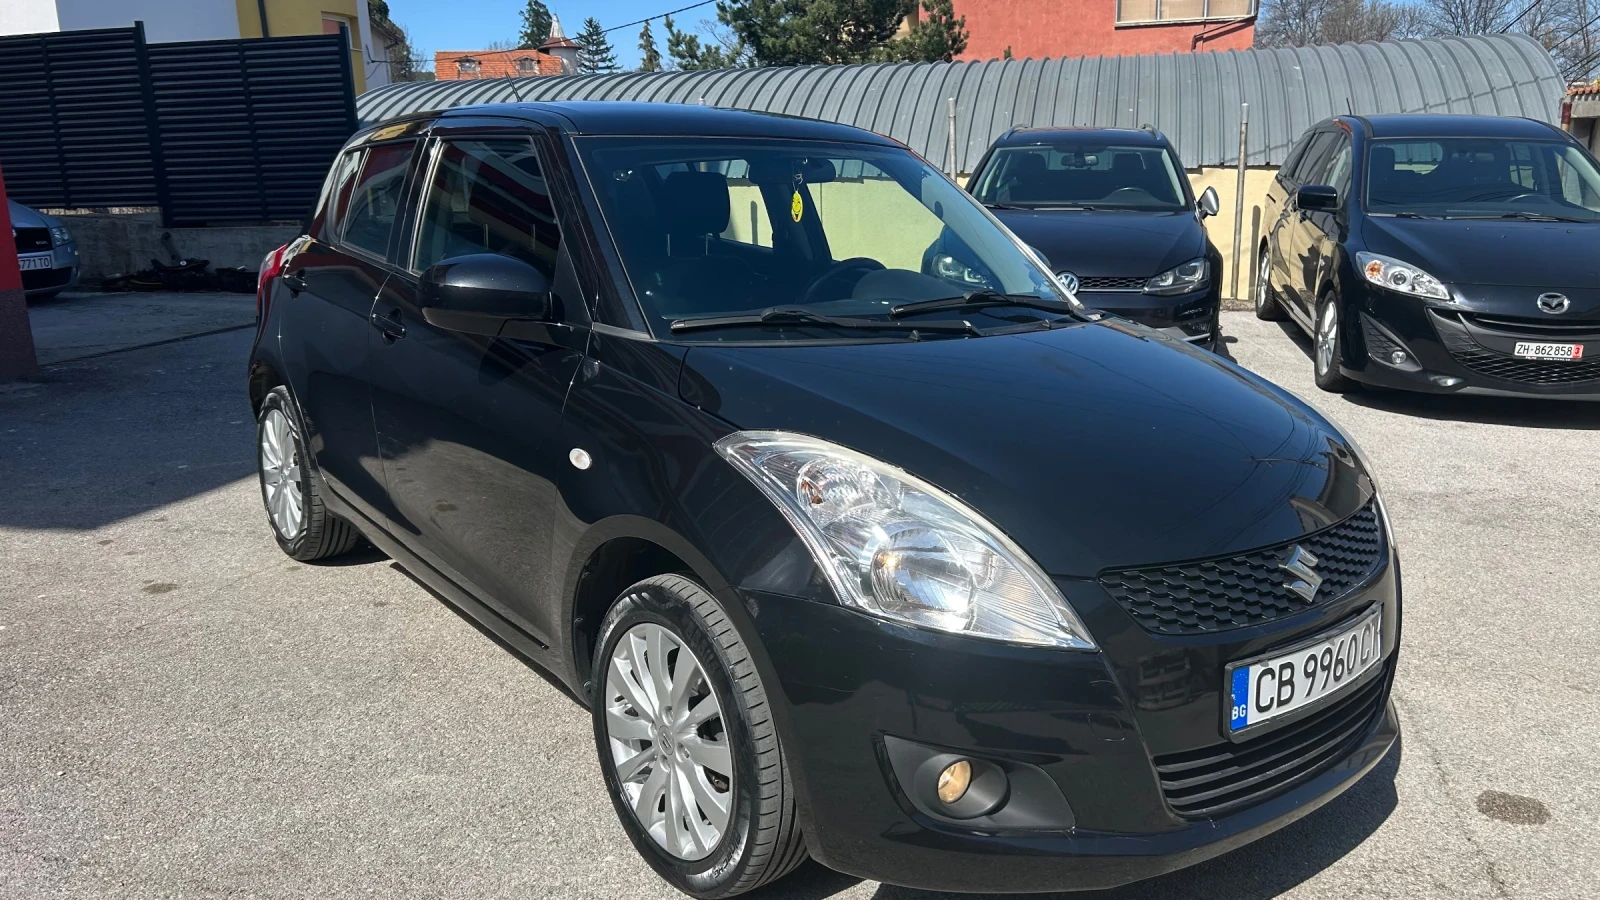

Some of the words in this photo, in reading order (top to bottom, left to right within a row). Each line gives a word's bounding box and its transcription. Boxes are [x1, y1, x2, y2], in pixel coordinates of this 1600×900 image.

[18, 258, 37, 270] 771
[1255, 661, 1296, 714] CB
[1303, 633, 1358, 699] 9960
[1231, 703, 1247, 721] BG
